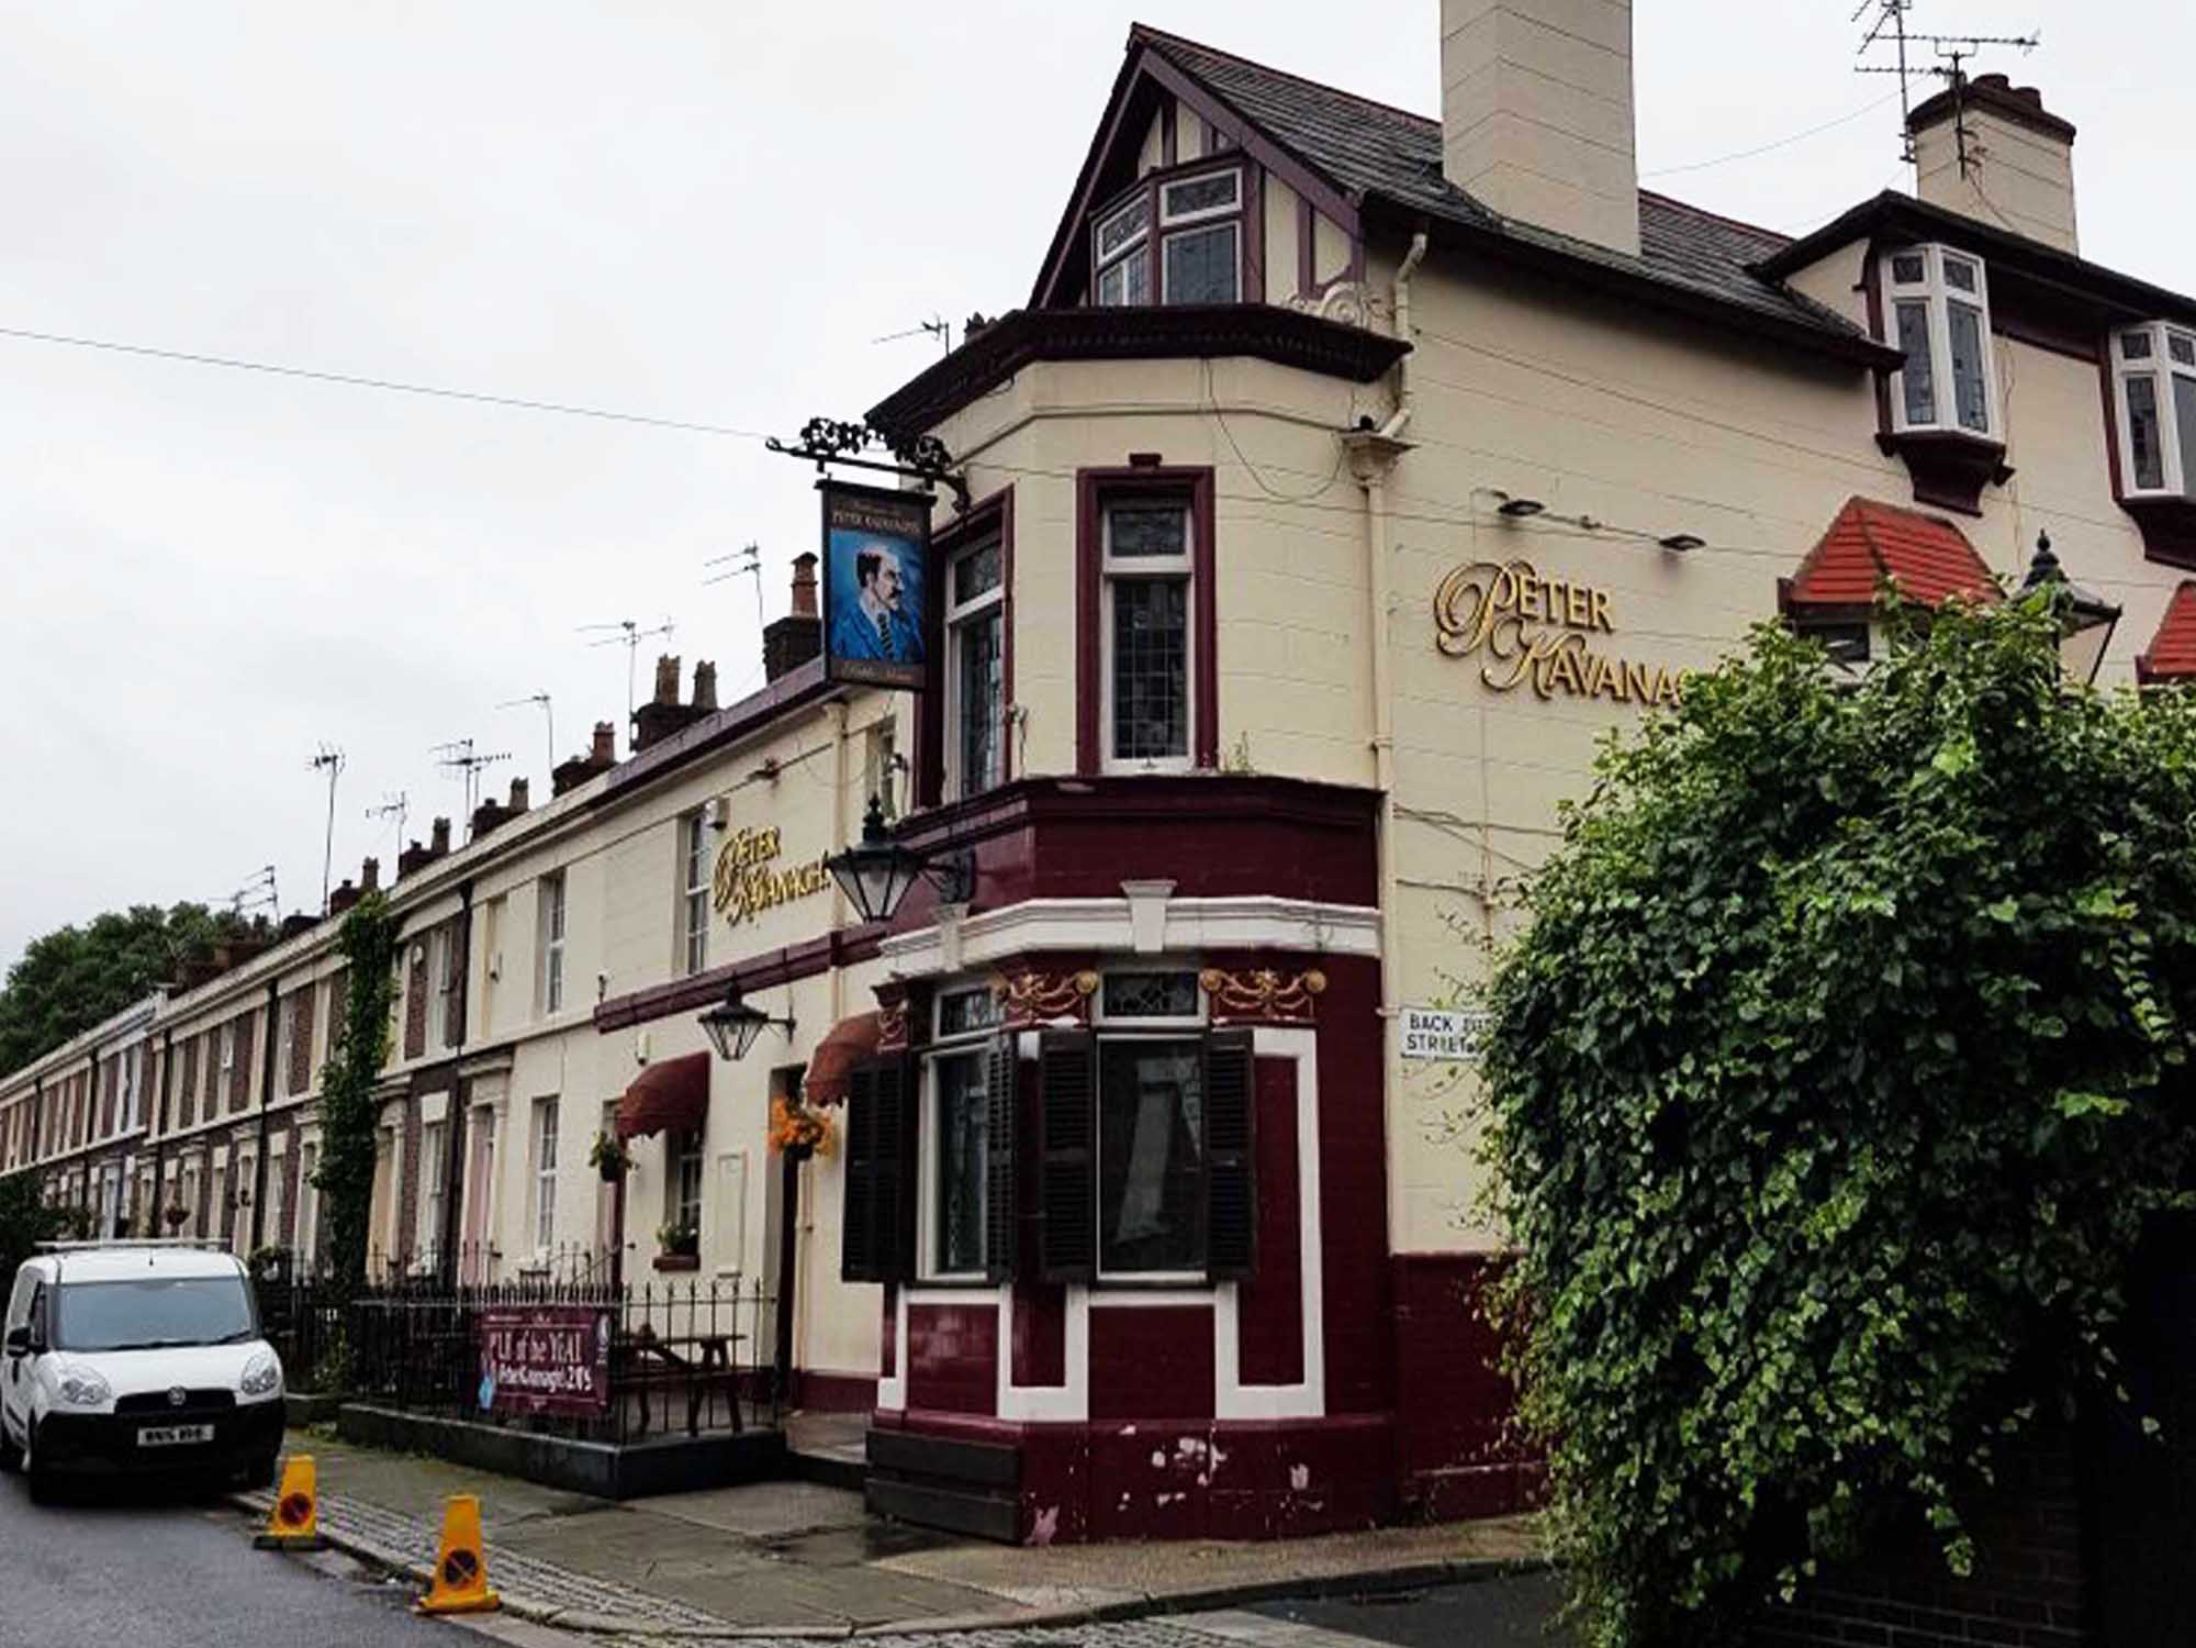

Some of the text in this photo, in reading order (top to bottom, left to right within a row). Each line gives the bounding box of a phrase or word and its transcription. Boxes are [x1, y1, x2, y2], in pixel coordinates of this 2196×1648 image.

[1434, 560, 1614, 658] PETER
[714, 828, 781, 914] PETER
[1409, 1013, 1453, 1032] BACK
